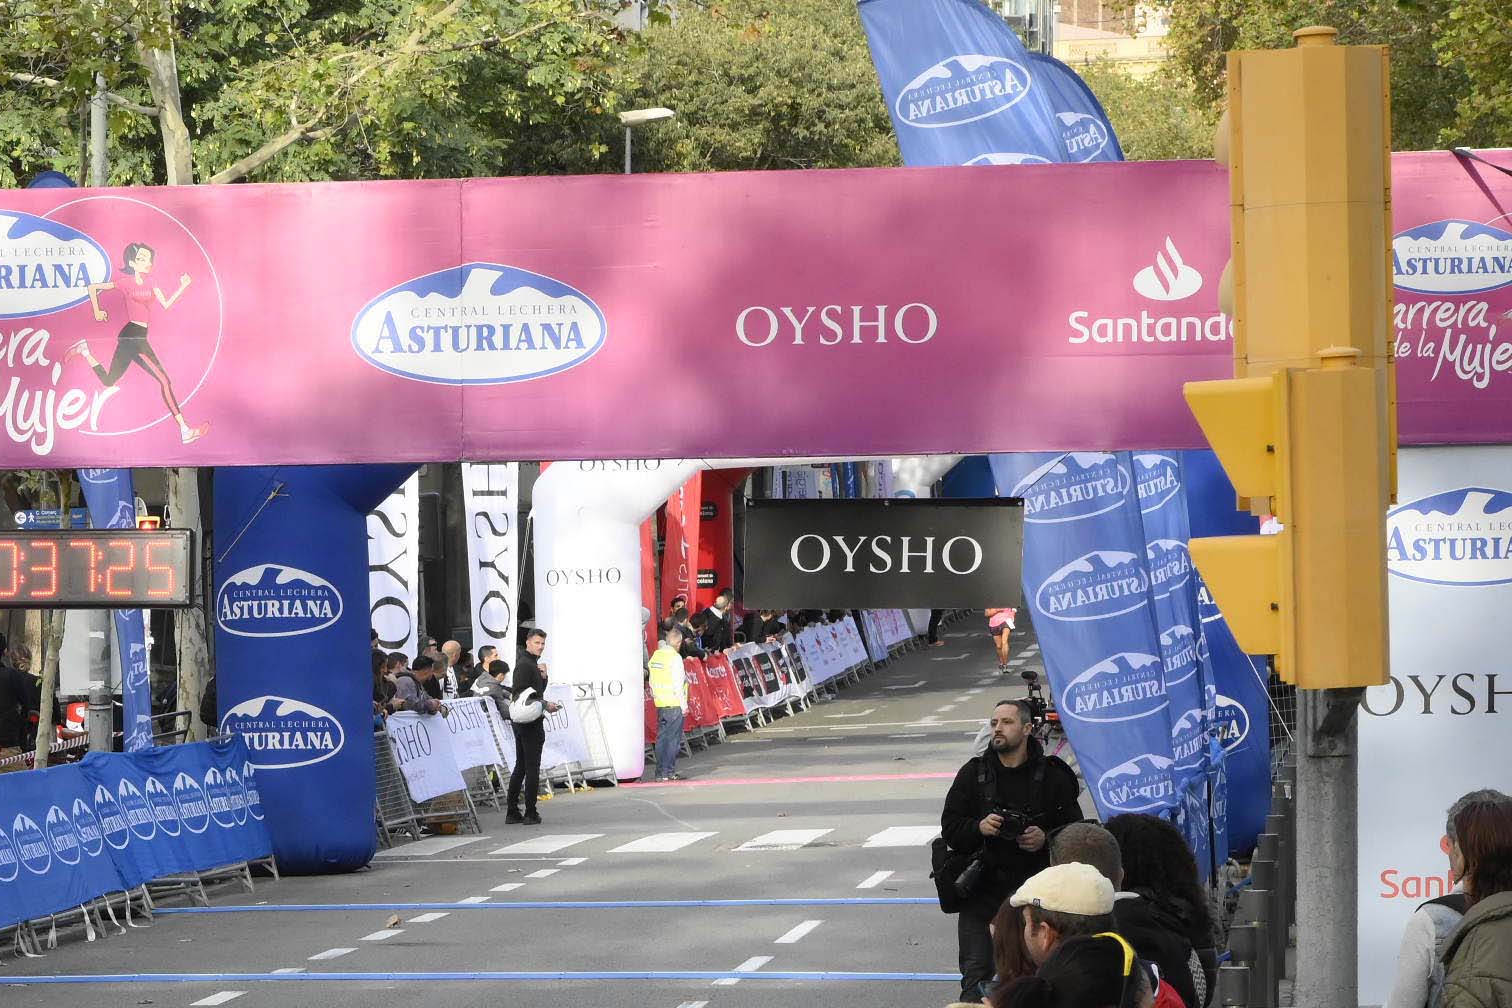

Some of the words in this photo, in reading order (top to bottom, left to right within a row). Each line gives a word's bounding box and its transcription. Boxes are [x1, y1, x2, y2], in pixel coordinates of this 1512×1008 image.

[13, 247, 87, 258] LECHERA
[1408, 246, 1458, 254] CENTRAL
[1464, 245, 1512, 253] LECHER
[411, 305, 489, 318] CENTRAL
[497, 304, 578, 316] LECHERA
[1393, 300, 1489, 329] arrera
[371, 310, 587, 355] ASTURIANA
[735, 302, 938, 347] OYSHO
[1417, 331, 1435, 358] la
[1430, 324, 1512, 389] Muje
[1415, 521, 1482, 533] CENTRAL
[790, 534, 984, 576] OYSHO
[546, 567, 622, 587] OYSHO
[233, 589, 275, 598] CENTRAL
[280, 588, 329, 597] LECHERA
[221, 594, 333, 621] ASTURIANA
[577, 679, 624, 698] SHO
[280, 720, 330, 729] LECHERA
[225, 725, 335, 750] ATURIANA
